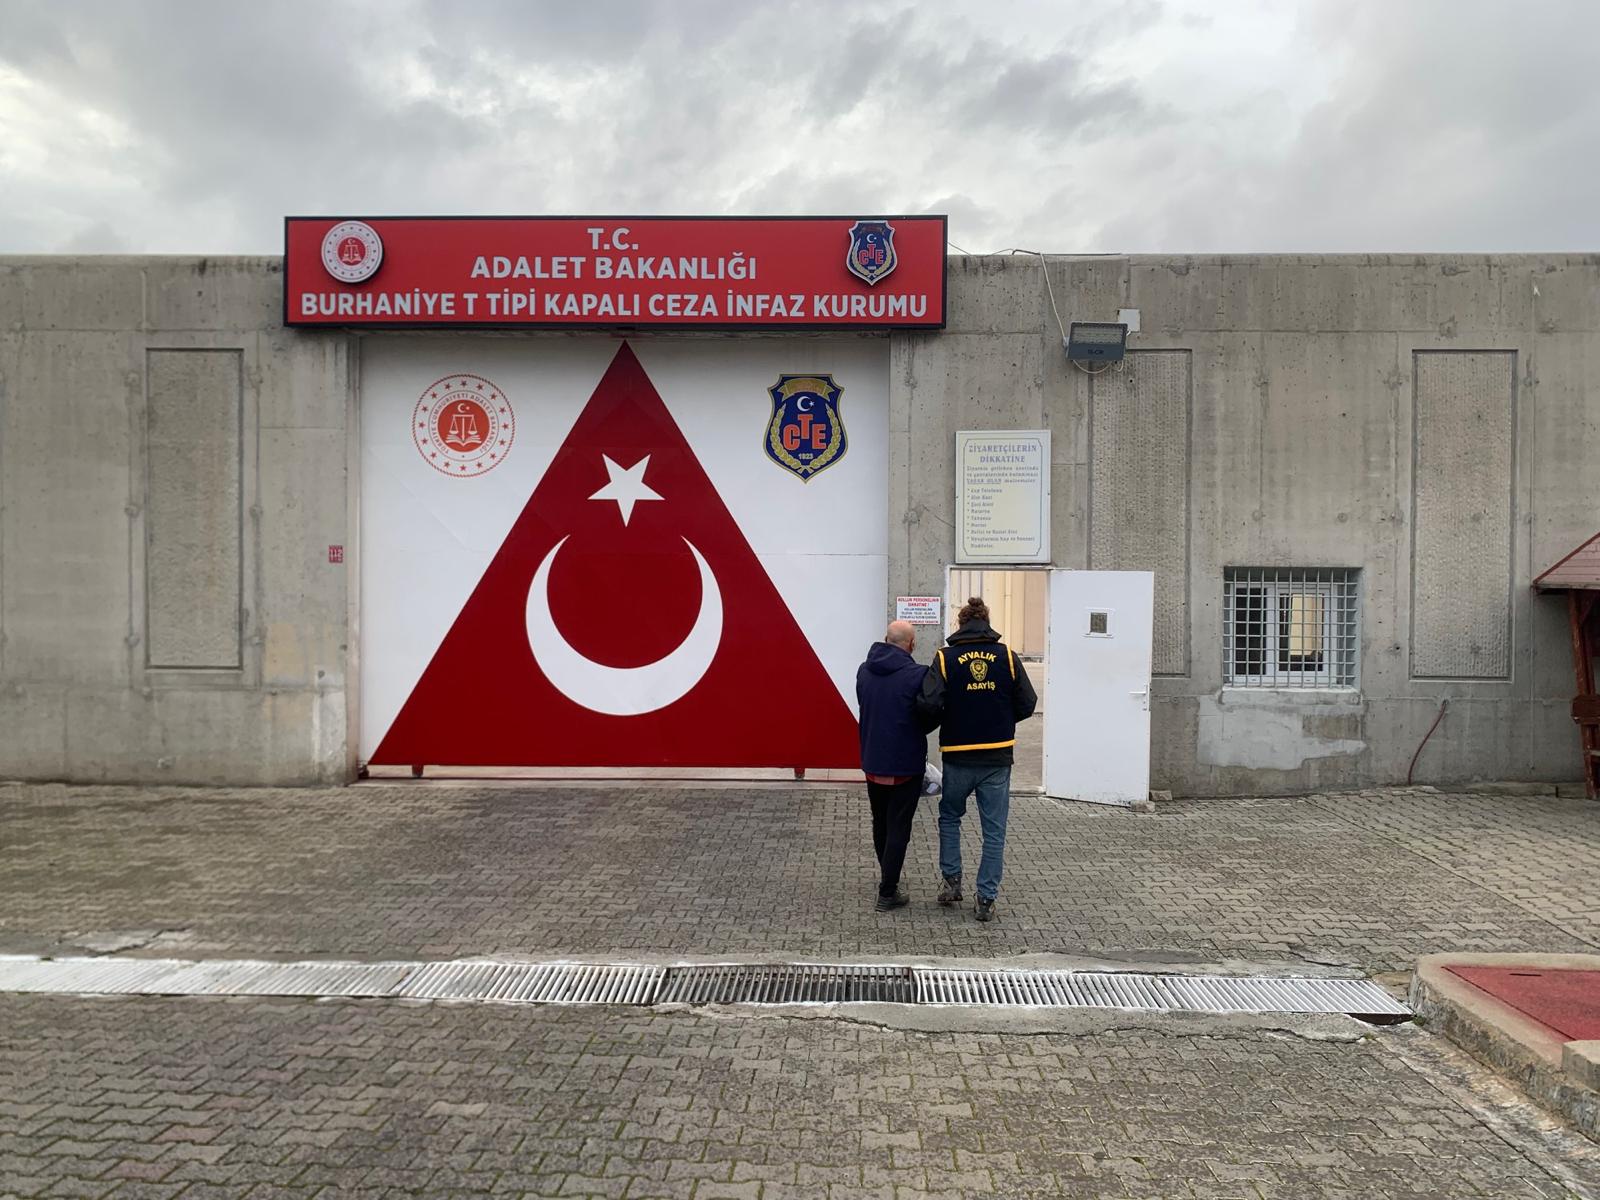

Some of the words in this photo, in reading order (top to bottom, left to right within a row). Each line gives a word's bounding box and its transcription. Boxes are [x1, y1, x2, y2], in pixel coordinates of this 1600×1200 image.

[588, 228, 639, 250] T.C.
[471, 256, 585, 278] ADALET
[595, 252, 756, 280] BAKANLIĞI
[302, 288, 455, 315] BURHANİYE
[463, 293, 478, 315] T
[486, 288, 536, 316] TİPİ
[545, 293, 640, 316] KAPALI
[650, 294, 718, 317] CEZA
[727, 289, 805, 317] İNFAZ
[814, 294, 927, 318] KURUMU
[783, 413, 827, 450] CTE
[958, 651, 997, 664] AYVALIK
[967, 680, 996, 691] ASAYİŞ
